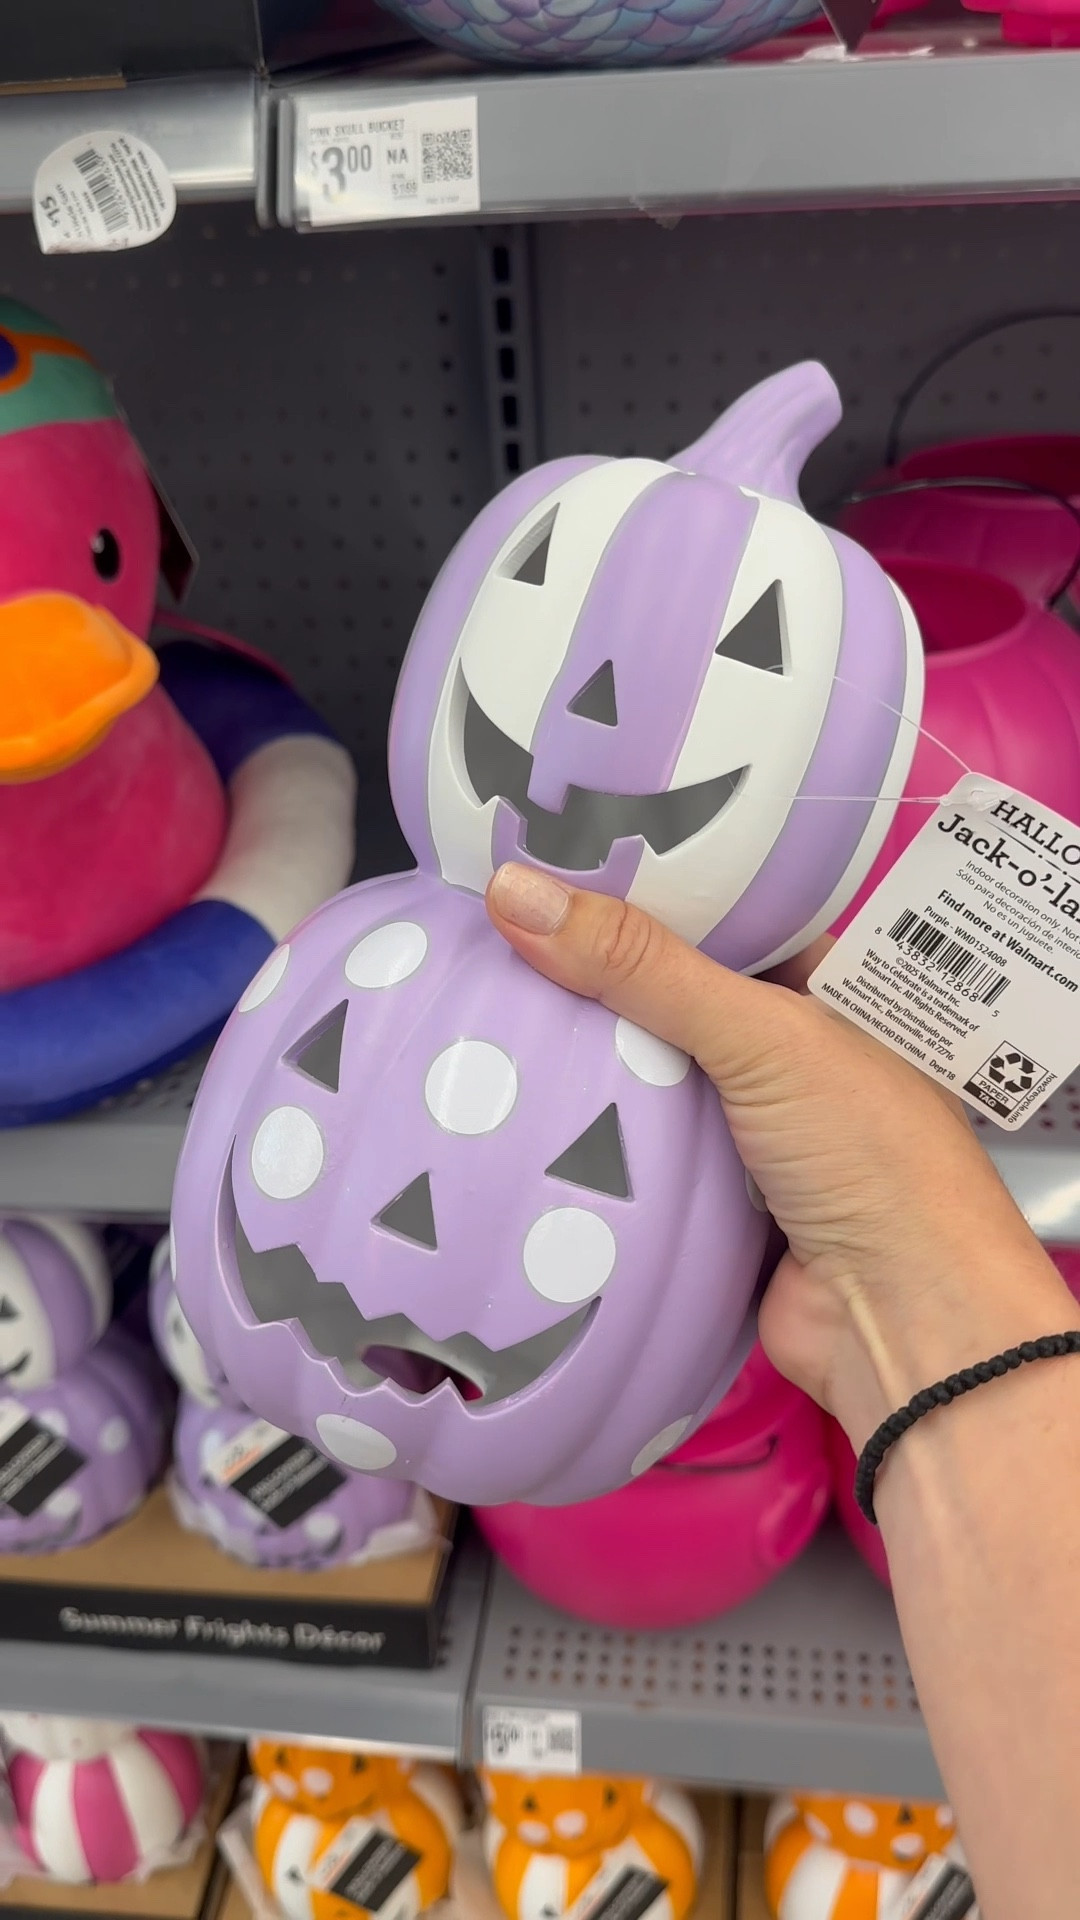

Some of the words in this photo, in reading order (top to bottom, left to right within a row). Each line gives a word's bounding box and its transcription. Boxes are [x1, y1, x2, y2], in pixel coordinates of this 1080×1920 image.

[334, 123, 364, 136] SKULL
[368, 119, 405, 134] BUCKET
[937, 813, 1080, 928] Jack-o’-la
[955, 868, 975, 886] Sólo
[973, 883, 995, 899] para
[994, 897, 1042, 932] decoración
[1041, 929, 1054, 940] de
[965, 859, 995, 883] Indoor
[994, 881, 1040, 915] decoration
[1040, 913, 1061, 930] only.
[1061, 926, 1080, 942] Not
[923, 905, 950, 928] Purple
[954, 925, 1007, 967] WMD1524008
[937, 889, 965, 913] Find
[961, 908, 992, 933] more
[991, 929, 1006, 943] at
[1005, 936, 1080, 992] Walmart.com
[982, 900, 997, 913] No
[996, 911, 1007, 921] es
[1007, 918, 1020, 930] un
[1016, 925, 1053, 954] juguete.
[861, 958, 892, 984] Walmart
[889, 979, 902, 993] Inc.
[902, 989, 915, 1000] All
[912, 995, 935, 1016] Rights
[933, 1011, 968, 1039] Reserved.
[866, 948, 882, 965] Way
[880, 960, 890, 970] to
[889, 965, 922, 993] Celebrate
[920, 988, 928, 997] is
[932, 997, 970, 1027] trademark
[968, 1023, 980, 1032] of
[874, 926, 882, 935] 8
[896, 940, 936, 972] 43832
[940, 971, 979, 1002] 12868
[991, 1009, 1000, 1018] 5
[917, 971, 949, 998] Walmart
[946, 993, 960, 1008] Inc.
[821, 982, 843, 1001] MADE
[840, 996, 851, 1007] IN
[849, 1002, 896, 1038] CHINA/HECHO
[893, 1034, 906, 1045] EN
[903, 1041, 926, 1061] CHINA
[928, 1059, 947, 1075] Dept
[946, 1070, 956, 1081] 18
[841, 977, 872, 1003] Walmart
[870, 998, 884, 1014] Inc.,
[884, 1008, 924, 1042] Bentonville,
[923, 1037, 937, 1049] AR
[934, 1043, 955, 1061] 72716
[855, 975, 895, 1006] Distributed
[892, 1000, 940, 1039] by/Distribuido
[937, 1035, 953, 1047] por
[978, 1079, 1009, 1104] PAPER
[978, 1090, 997, 1107] TAG
[1007, 1072, 1058, 1123] how2recycle.info
[58, 1606, 181, 1640] Summer
[184, 1614, 290, 1649] Frights
[293, 1622, 386, 1655] Décor
